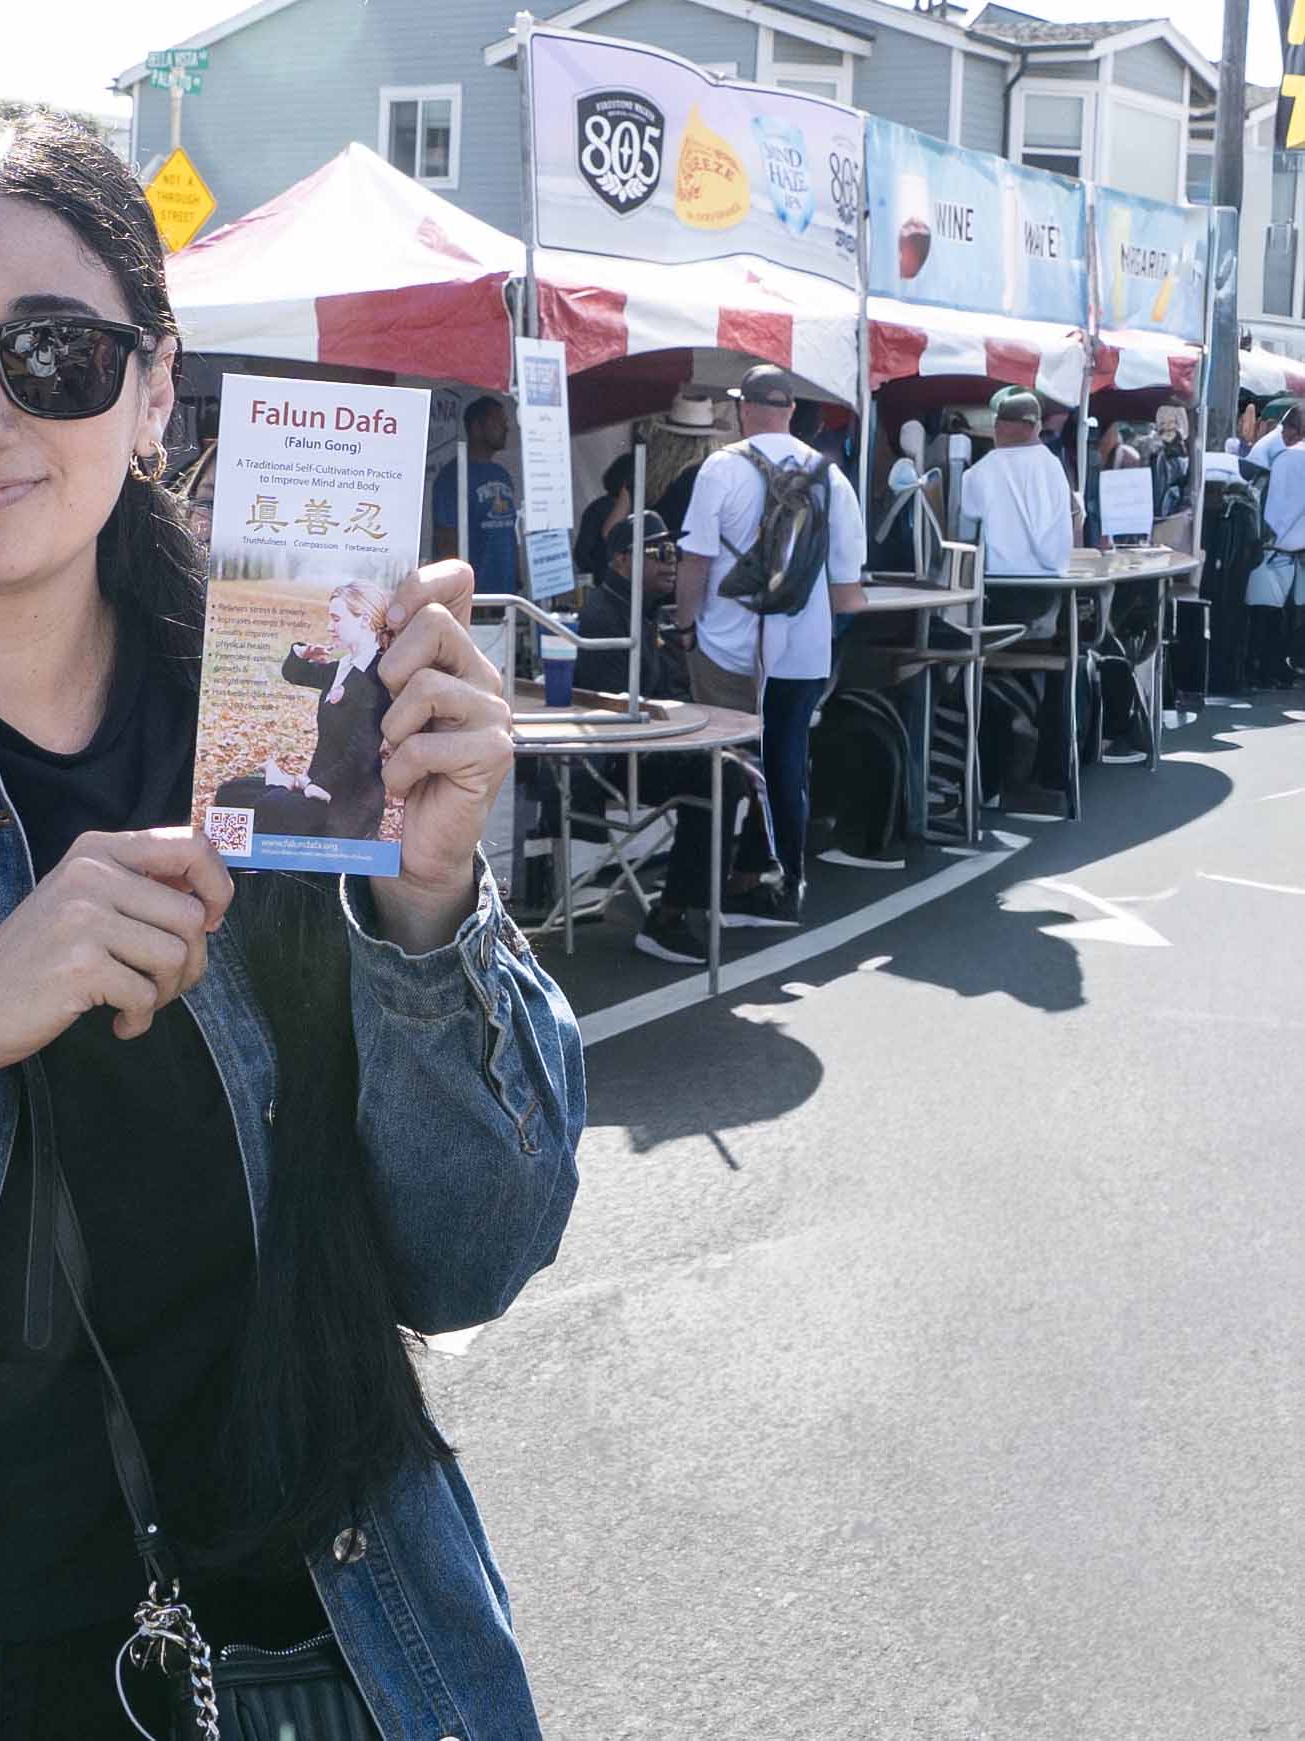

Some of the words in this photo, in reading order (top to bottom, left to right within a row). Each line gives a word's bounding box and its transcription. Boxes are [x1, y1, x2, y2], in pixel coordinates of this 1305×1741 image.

[581, 114, 662, 185] 805
[164, 175, 180, 185] NOT
[157, 191, 199, 204] THROUGH
[160, 209, 195, 223] STREET
[934, 202, 974, 242] WINE
[250, 399, 326, 429] Falun
[334, 406, 398, 435] Dafa
[284, 436, 322, 451] (Falun
[324, 439, 362, 455] Gong)
[236, 460, 244, 468] A
[245, 459, 294, 473] Traditional
[295, 462, 366, 477] Self-Cultivation
[366, 468, 402, 480] Practice
[259, 474, 270, 484] to
[271, 475, 310, 489] Improve
[311, 478, 336, 489] Mind
[336, 480, 356, 490] and
[356, 481, 381, 493] Body
[293, 539, 339, 551] Compassion
[215, 640, 246, 650] physical
[247, 641, 271, 650] health
